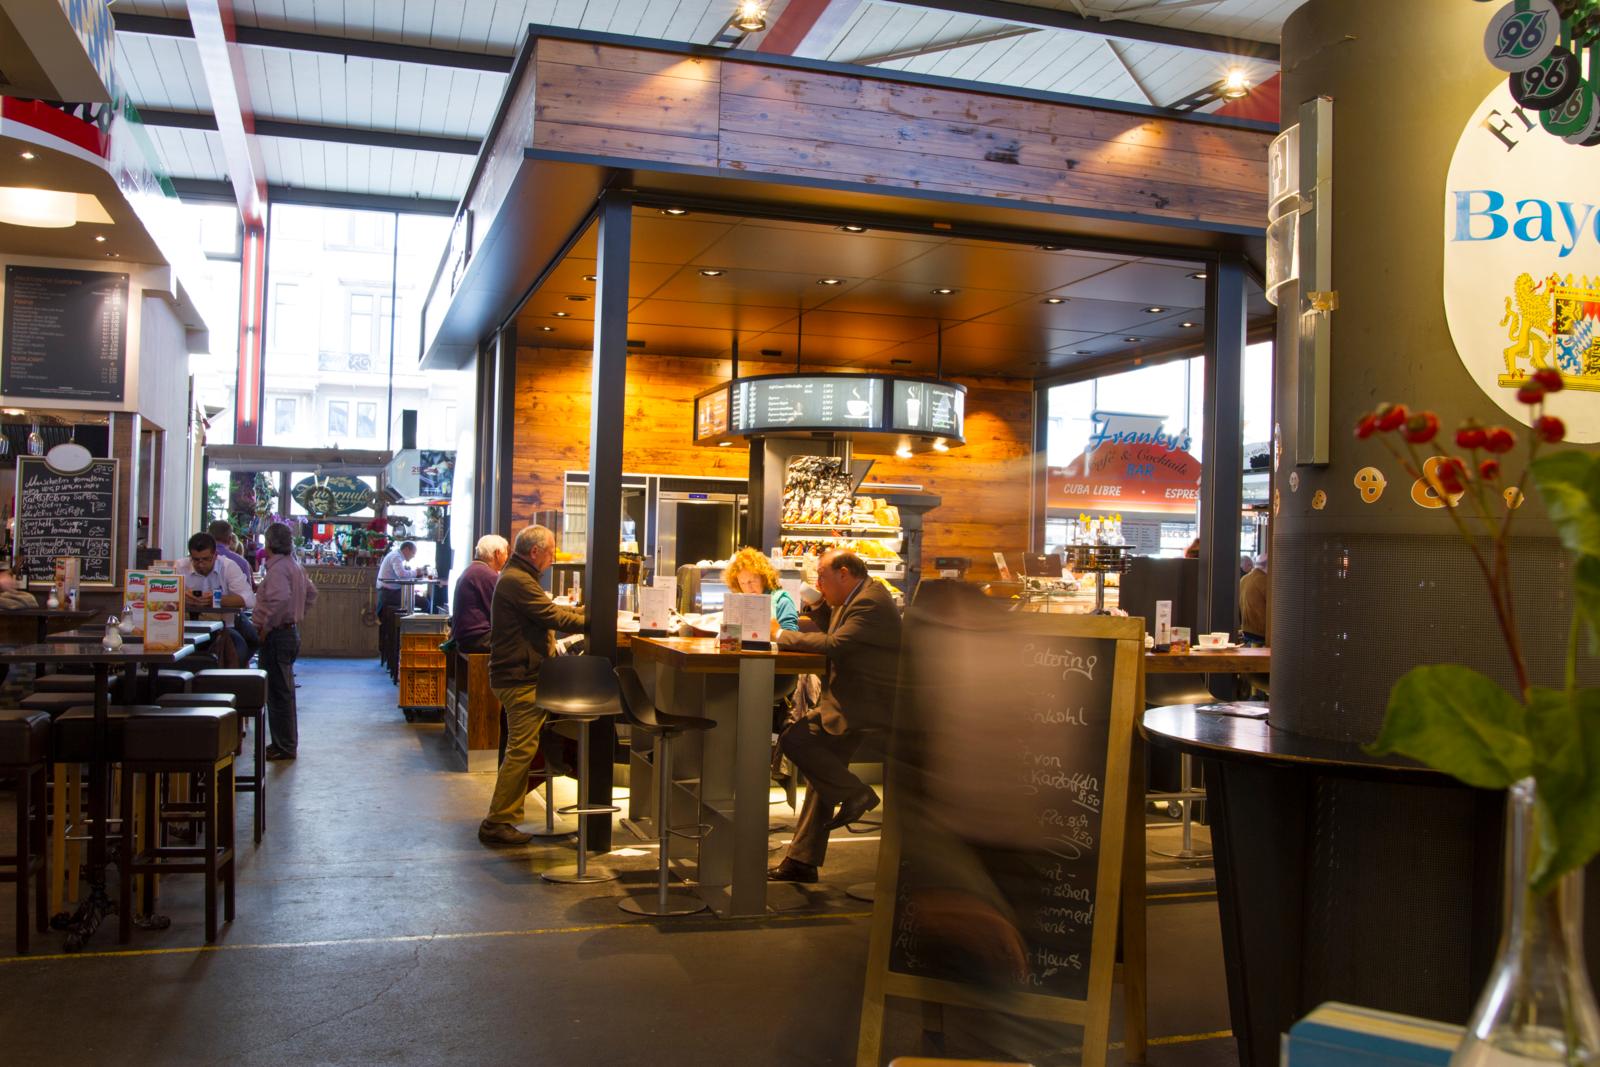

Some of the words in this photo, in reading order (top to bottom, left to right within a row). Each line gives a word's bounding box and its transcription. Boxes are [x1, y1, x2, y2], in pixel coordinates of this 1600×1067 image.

[1497, 10, 1549, 58] 96
[1522, 56, 1566, 98] 96
[1450, 189, 1600, 258] Bay
[1087, 411, 1192, 452] Franky's
[1126, 463, 1154, 479] BAR
[1137, 448, 1188, 475] Cocktails
[296, 484, 369, 502] Zubrnuß
[1064, 483, 1089, 496] CUBA
[1093, 485, 1122, 497] LIBRE
[1034, 753, 1061, 768] von
[1039, 947, 1082, 970] Haus
